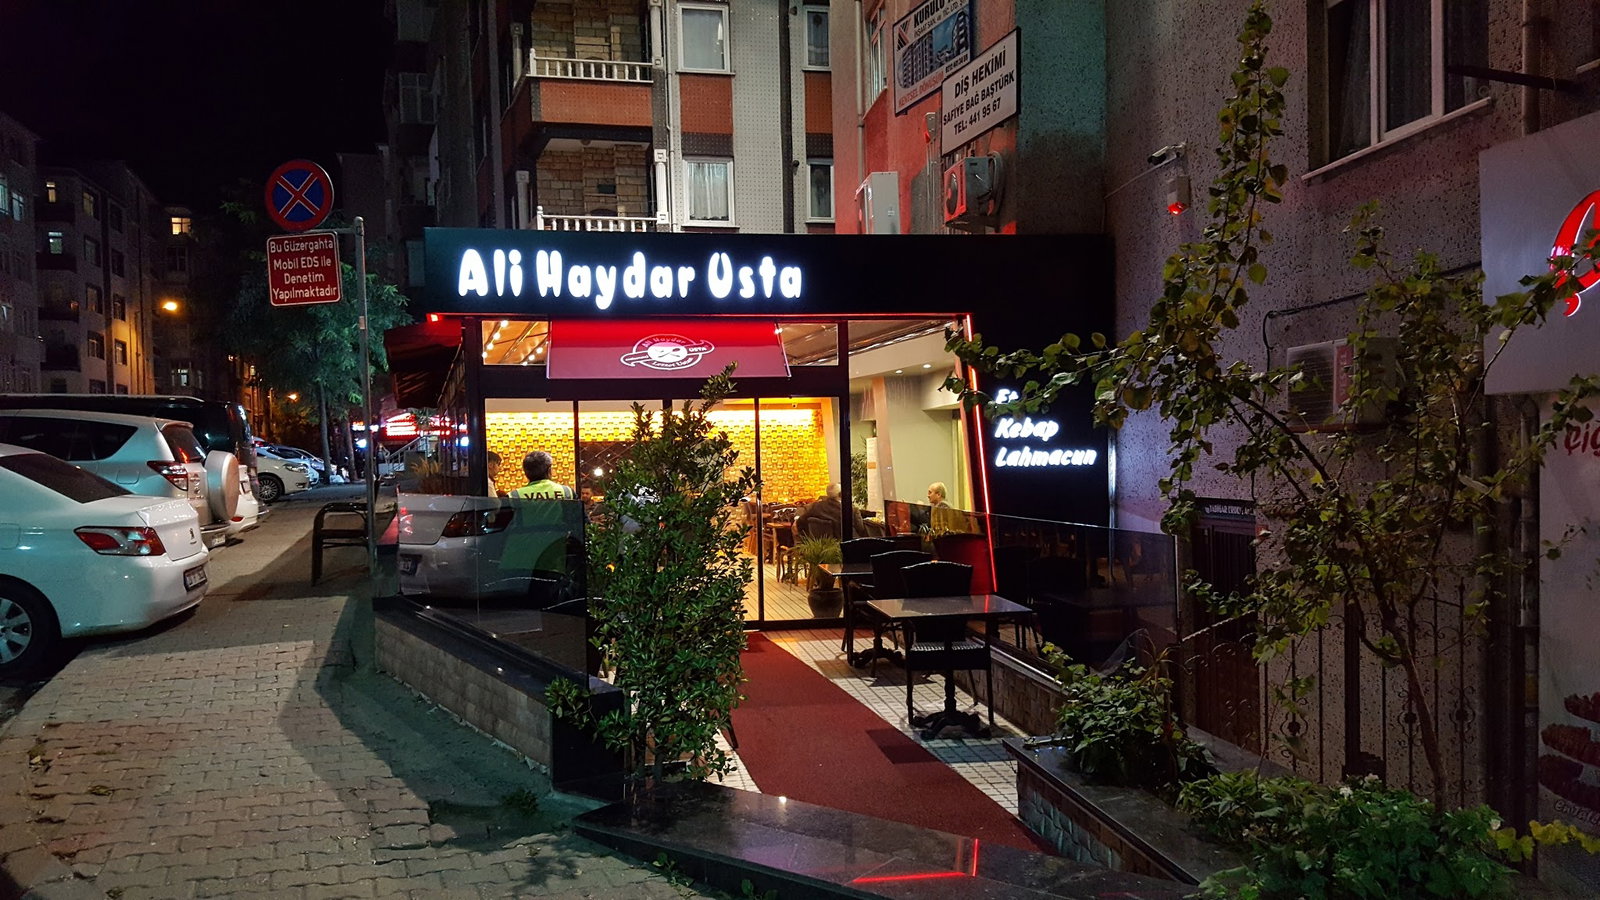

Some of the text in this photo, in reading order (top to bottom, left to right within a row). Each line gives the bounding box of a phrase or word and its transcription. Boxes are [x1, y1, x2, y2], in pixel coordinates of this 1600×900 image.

[954, 75, 970, 98] DİŞ
[972, 46, 1006, 87] HEKİMİ
[943, 69, 1015, 126] SAFİYE BAĞ BAŞTÜRK
[954, 97, 1001, 135] TEL: 441 95 67
[270, 238, 333, 253] Bu Güzergahta
[273, 255, 332, 270] Mobil EDS ile
[284, 272, 325, 284] Denetim
[457, 248, 802, 310] Ali Haydar Usta
[272, 284, 337, 302] Yapılmaktadır
[994, 416, 1060, 442] Kebap
[994, 445, 1098, 468] Lahmacun
